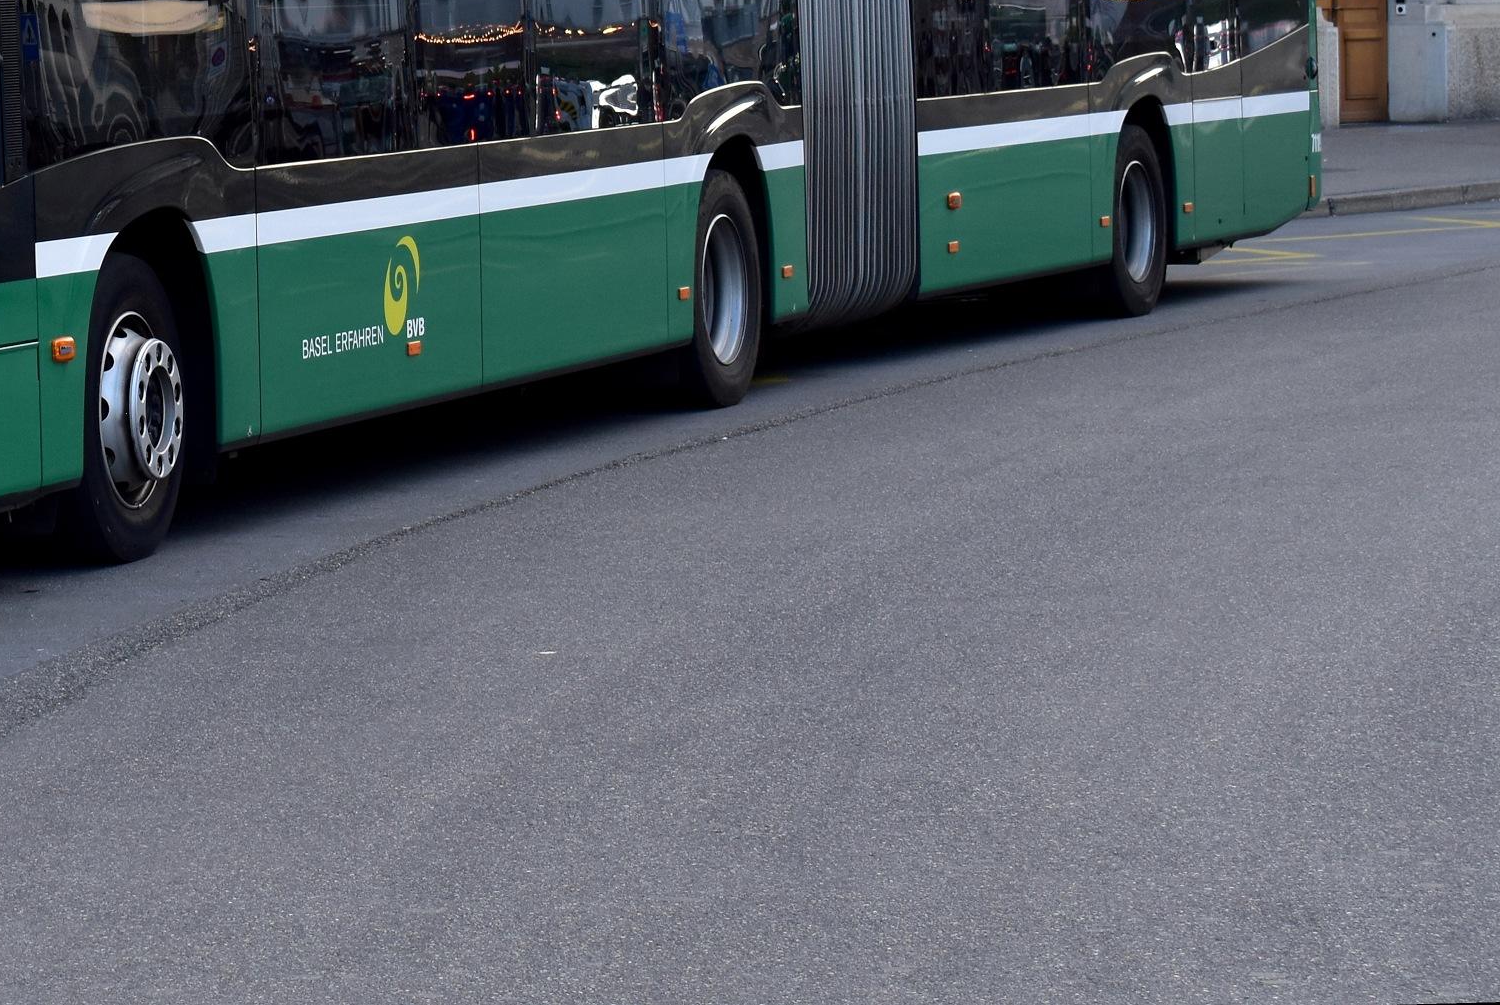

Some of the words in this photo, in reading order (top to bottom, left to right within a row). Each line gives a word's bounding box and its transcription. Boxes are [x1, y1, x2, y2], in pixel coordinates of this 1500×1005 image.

[407, 317, 425, 338] BVB
[302, 335, 332, 359] BASEL
[335, 325, 384, 353] ERFAHREN
